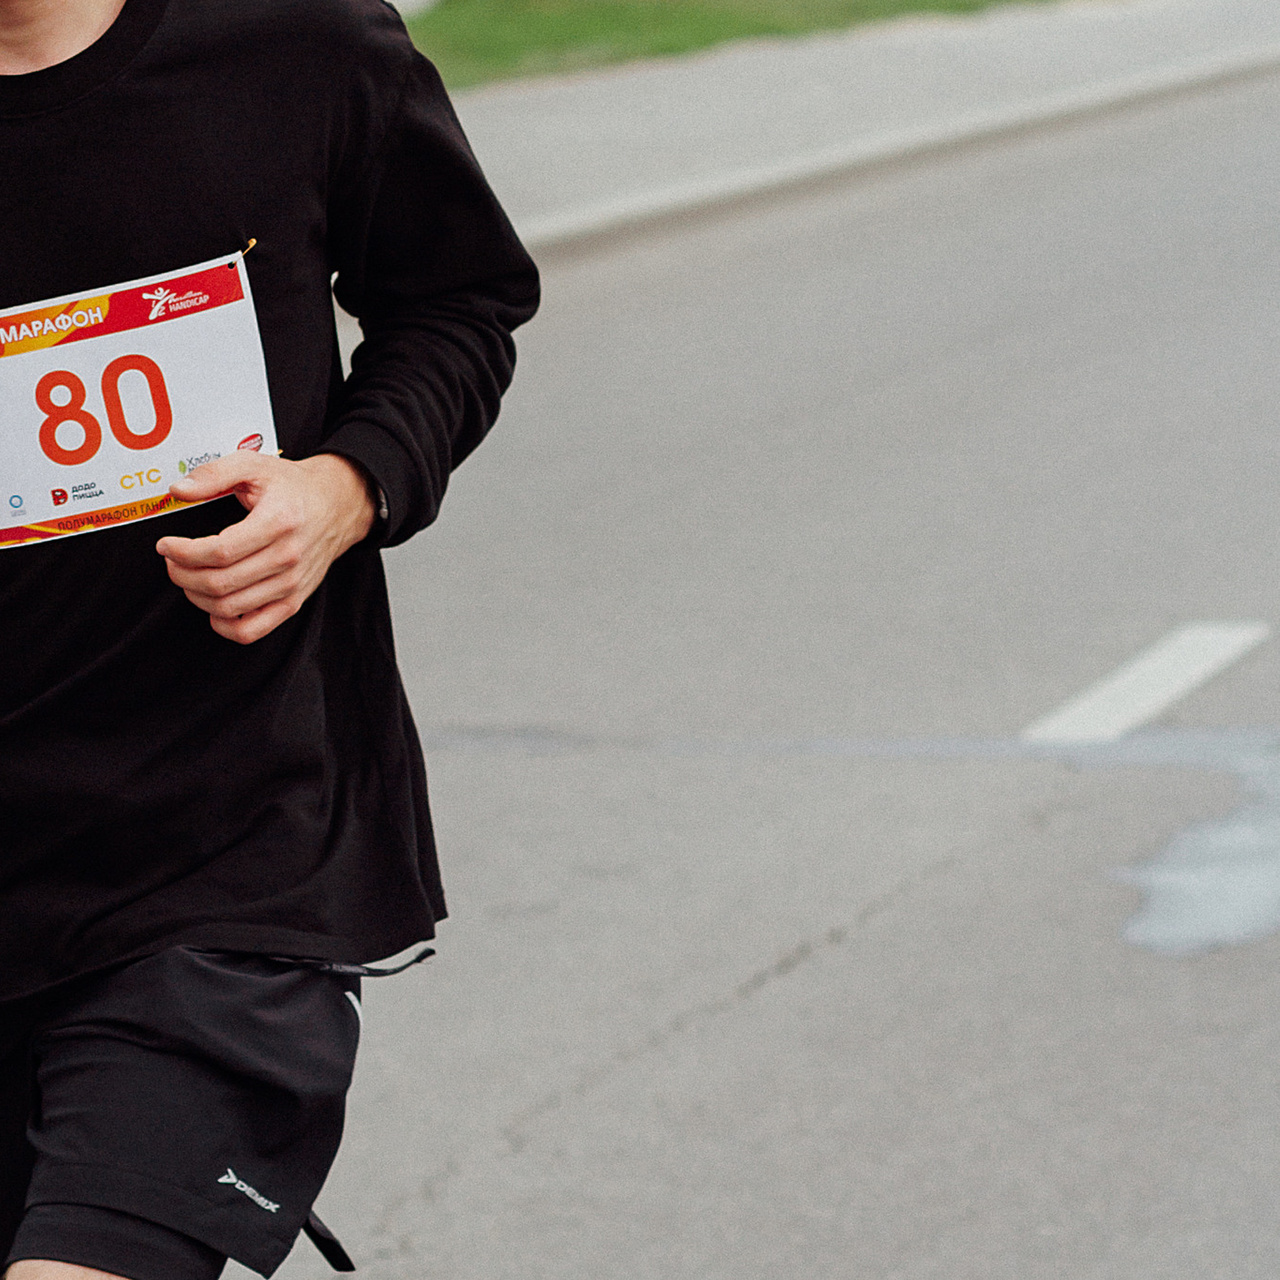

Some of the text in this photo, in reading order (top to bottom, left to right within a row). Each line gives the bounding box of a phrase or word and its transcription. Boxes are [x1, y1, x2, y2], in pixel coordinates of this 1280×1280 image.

[169, 295, 210, 312] HANDICAP
[35, 353, 173, 466] 80
[71, 482, 96, 493] ДОДО
[119, 467, 163, 490] СТС
[72, 489, 105, 501] ПИЦЦА
[57, 496, 184, 532] ПОЛУМАРАФОН ГАНДИК
